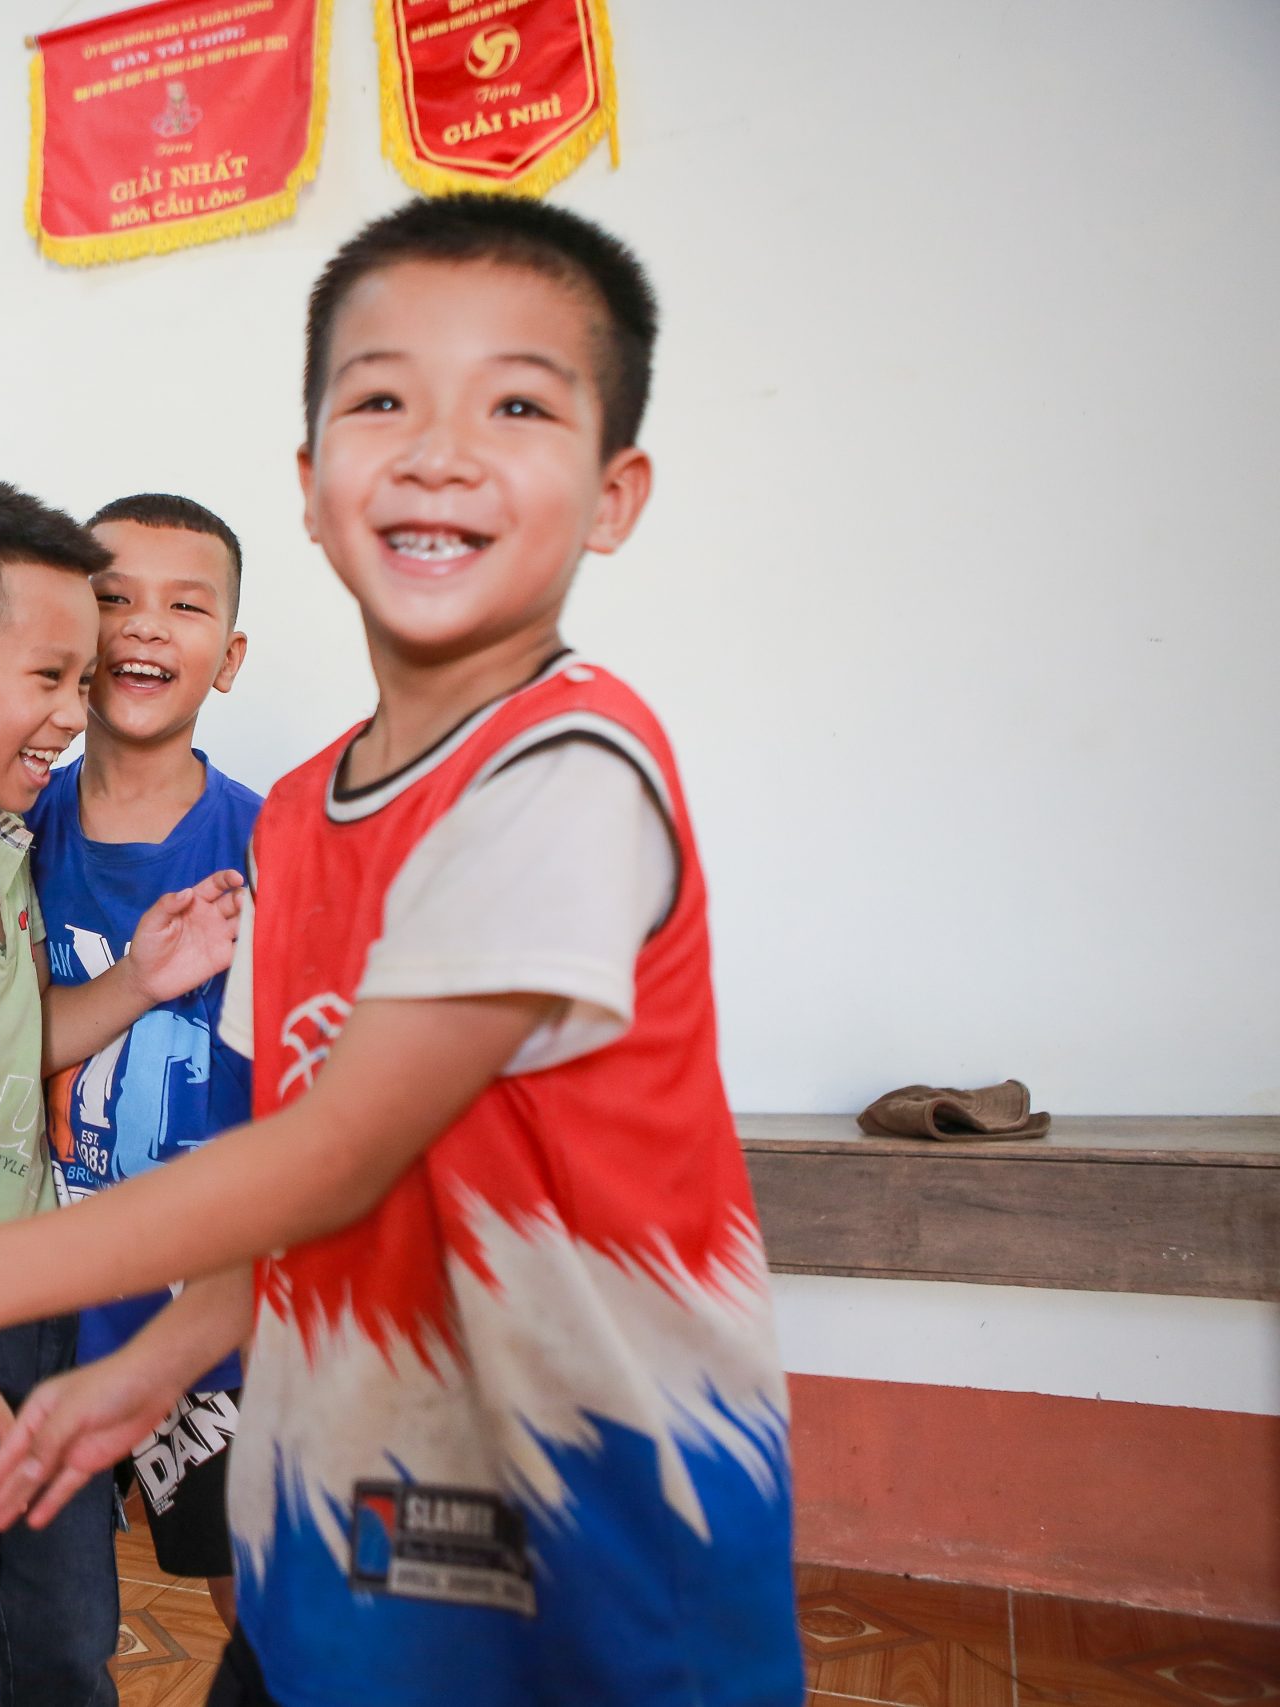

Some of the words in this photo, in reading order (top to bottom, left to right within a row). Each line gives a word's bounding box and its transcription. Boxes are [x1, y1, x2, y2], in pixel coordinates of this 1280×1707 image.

[442, 111, 503, 146] GIẢI
[508, 92, 562, 128] NHÌ
[110, 165, 164, 203] GIẢI
[170, 150, 249, 188] NHẤT
[154, 193, 194, 218] CẦU
[198, 185, 247, 212] LÔNG
[81, 1129, 99, 1146] EST.
[76, 1140, 108, 1175] 1983
